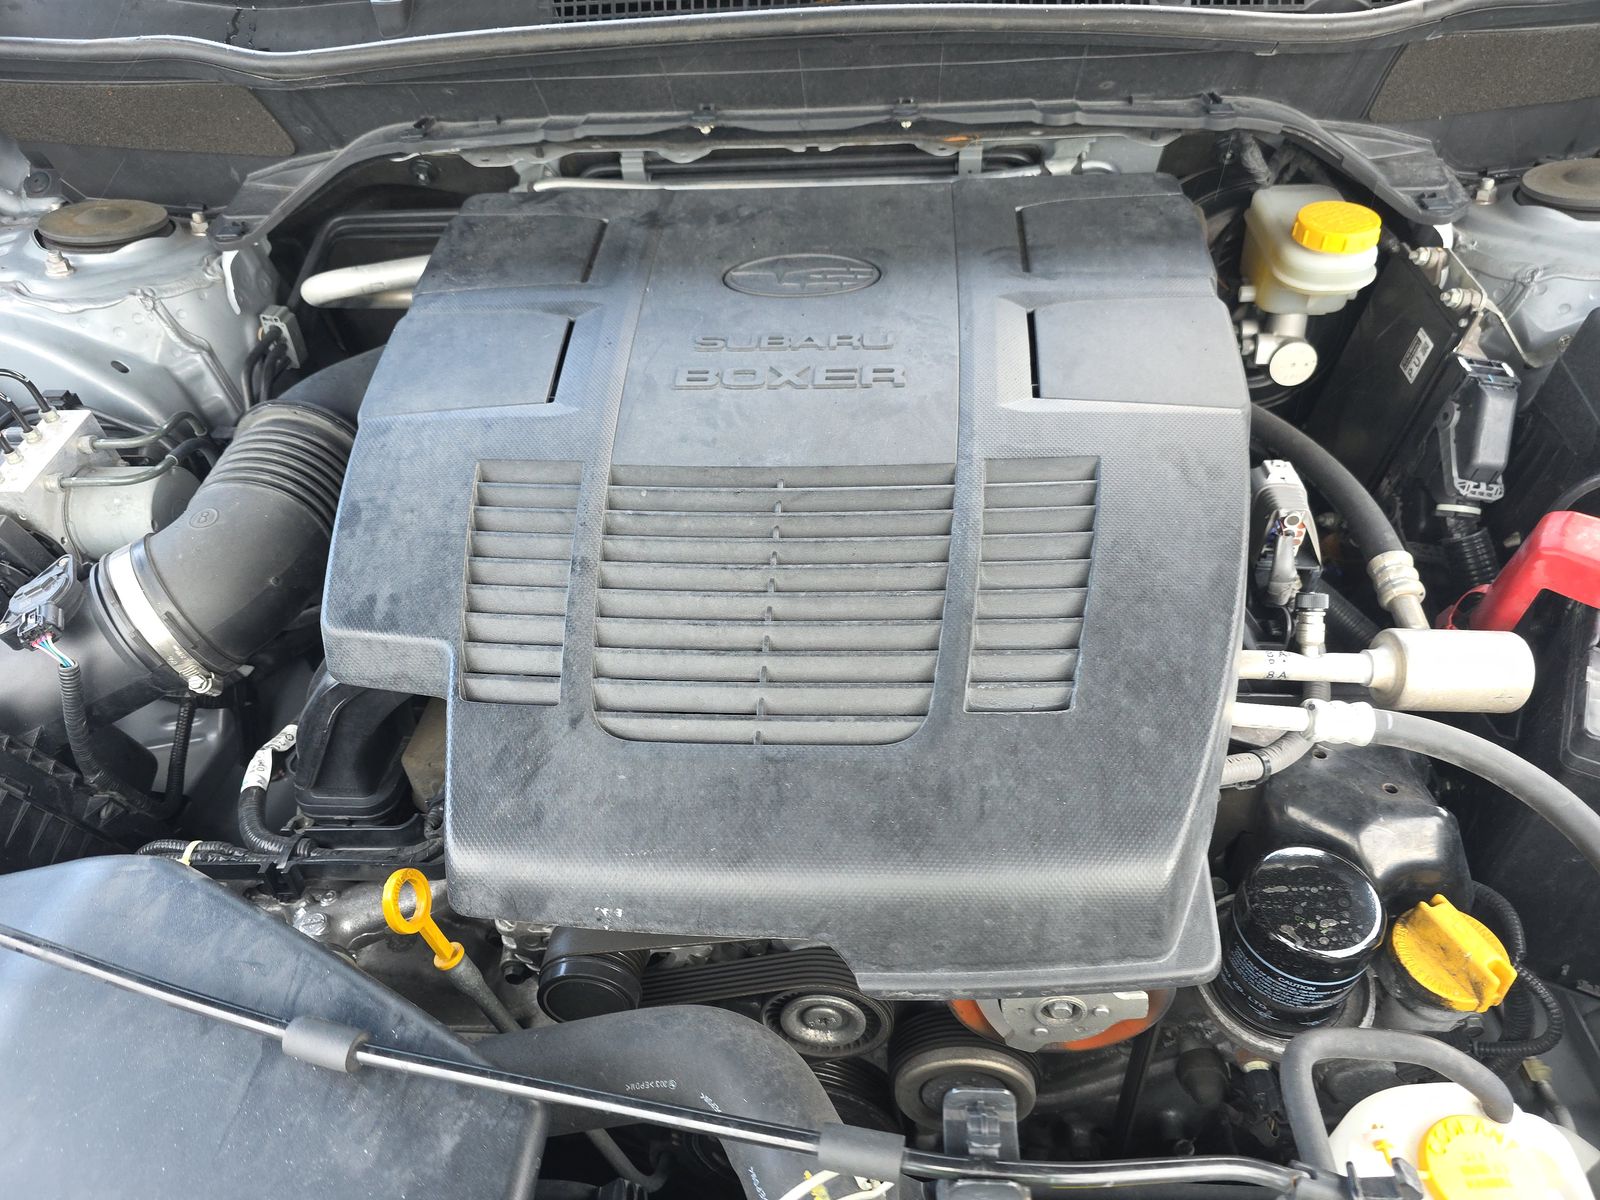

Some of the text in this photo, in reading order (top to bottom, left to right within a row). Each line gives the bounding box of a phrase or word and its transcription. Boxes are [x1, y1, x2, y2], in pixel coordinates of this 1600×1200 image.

[694, 333, 895, 351] SUBARU
[671, 363, 906, 390] BOXER
[1278, 977, 1317, 991] CAUTION
